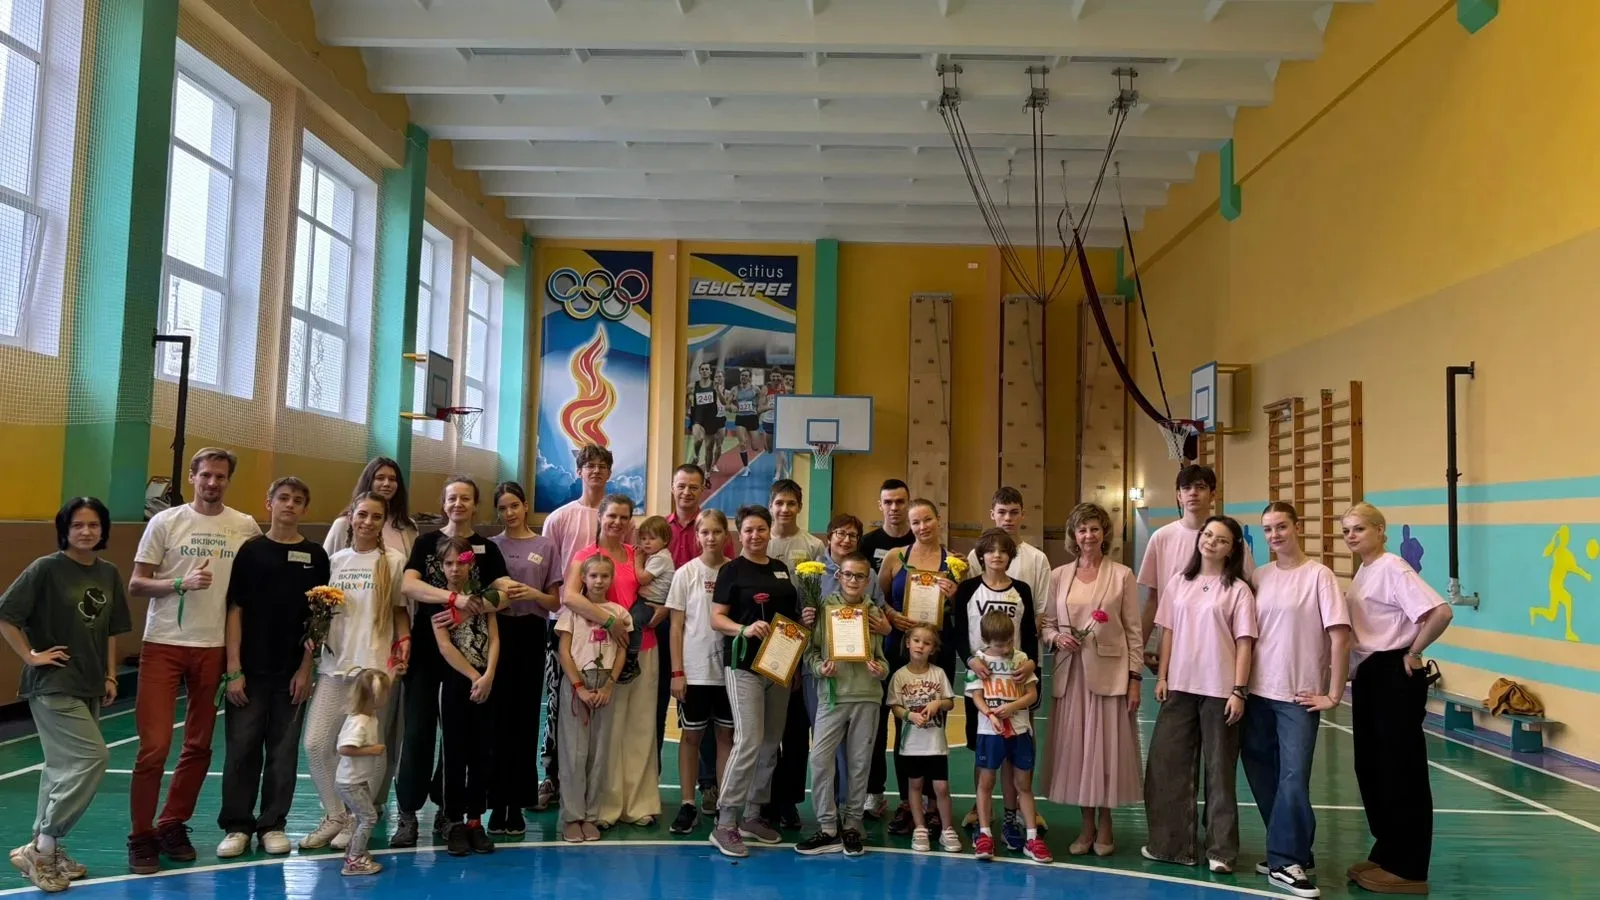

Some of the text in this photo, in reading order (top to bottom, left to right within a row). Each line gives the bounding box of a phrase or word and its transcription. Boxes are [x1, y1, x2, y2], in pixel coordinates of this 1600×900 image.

[738, 264, 783, 278] citius
[692, 280, 792, 297] БЫСТРЕЕ
[191, 538, 226, 546] ВКЛЮЧИ
[180, 545, 214, 557] Relax
